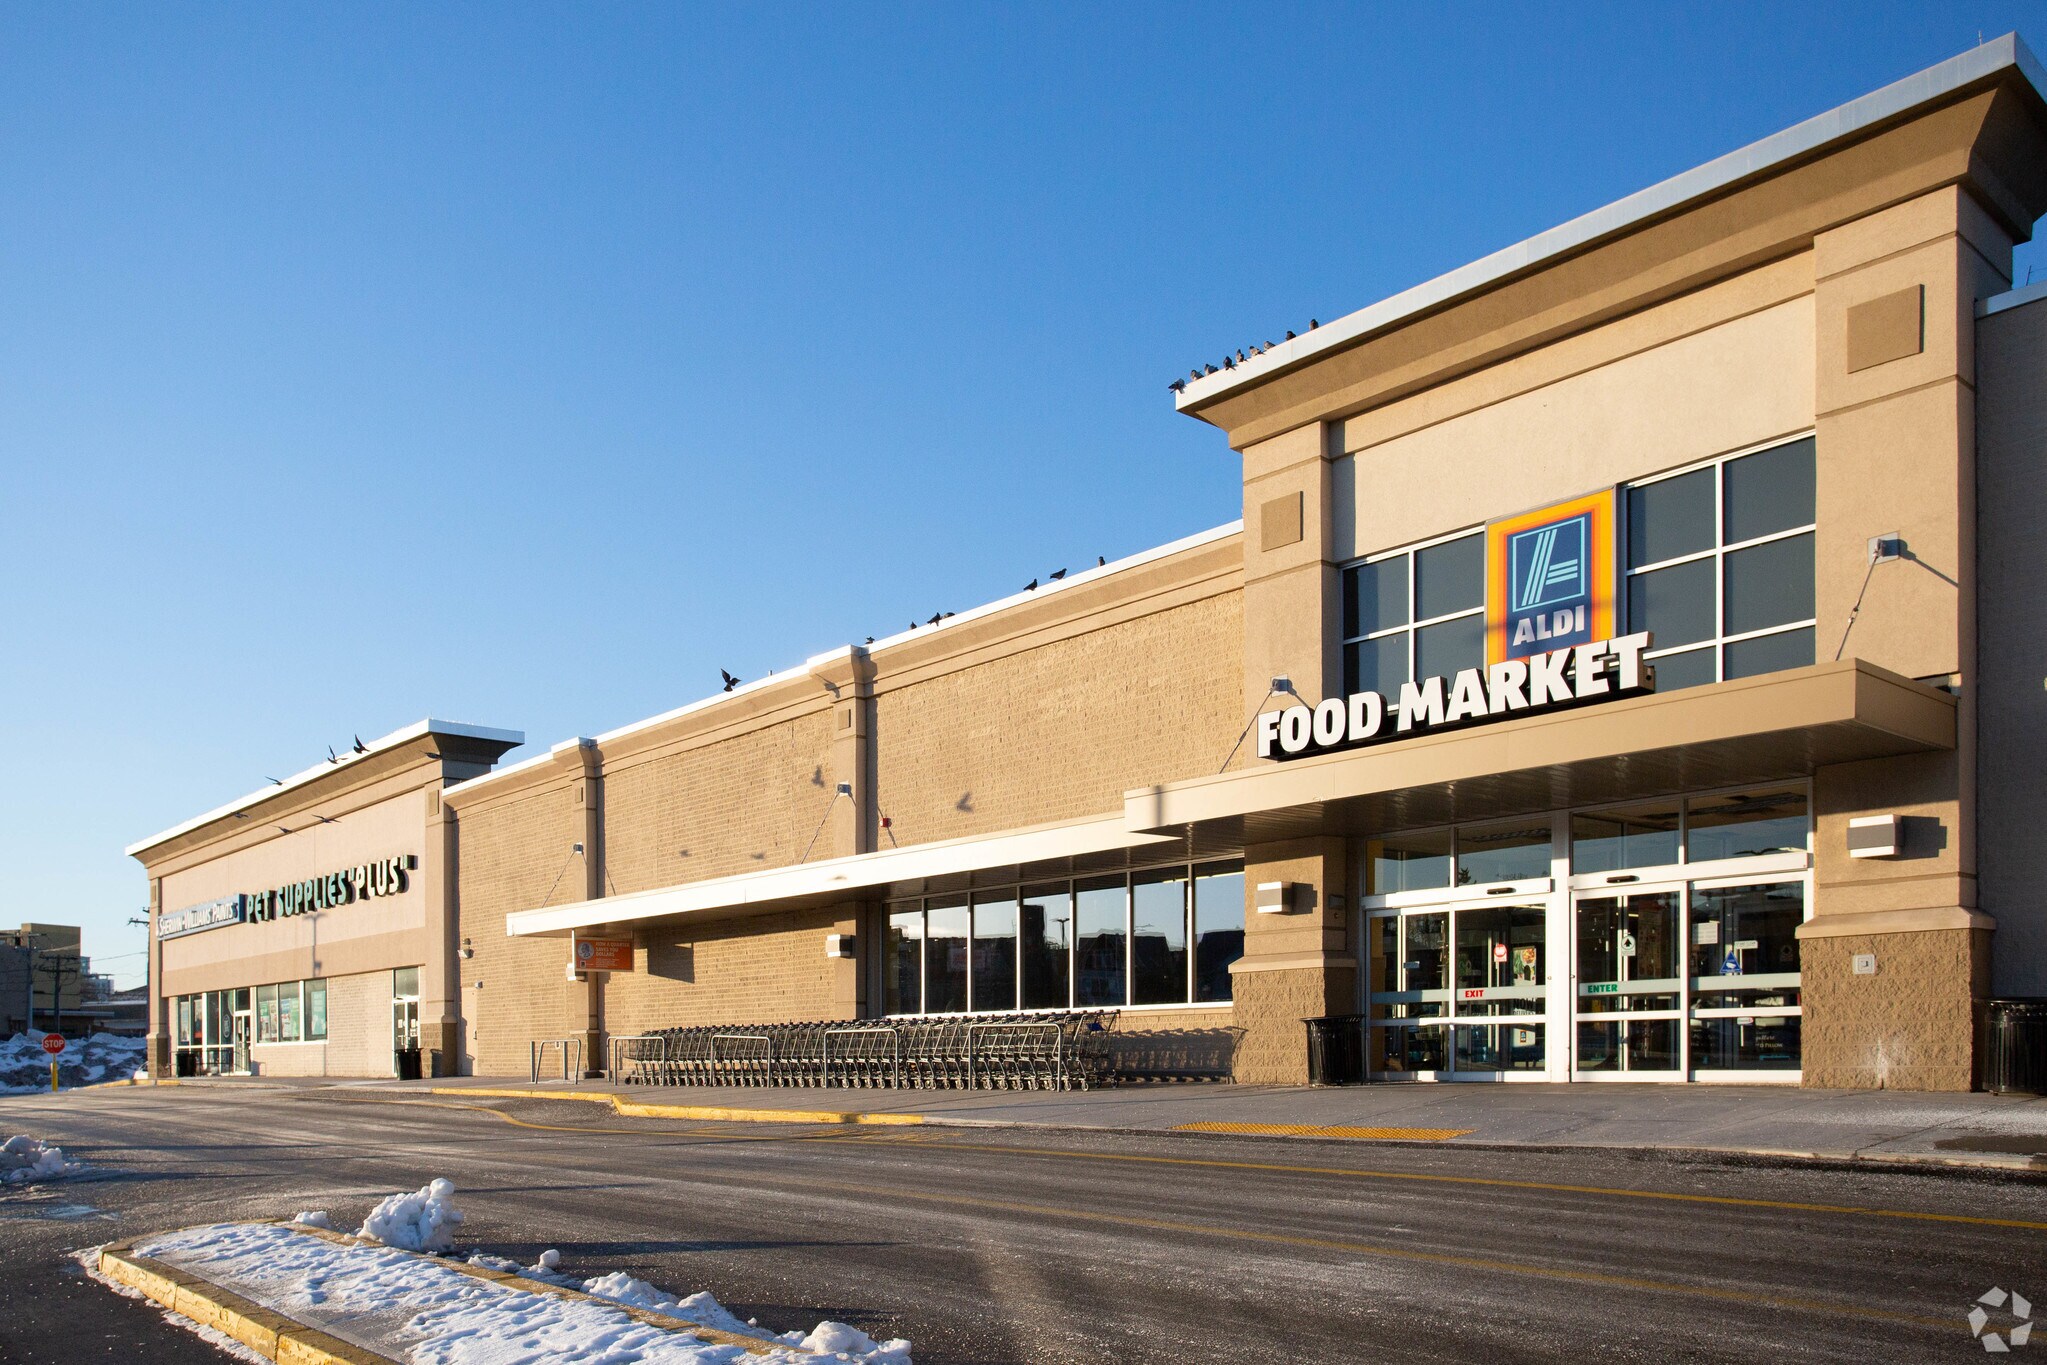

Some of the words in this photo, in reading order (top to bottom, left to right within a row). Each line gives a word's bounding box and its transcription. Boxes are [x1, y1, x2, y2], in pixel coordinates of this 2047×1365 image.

[1512, 605, 1585, 647] ALDI
[1257, 690, 1384, 759] FOOD
[1396, 630, 1653, 733] MARKET
[246, 890, 273, 923] PET
[276, 869, 348, 918] SUPPLIES
[1465, 989, 1484, 998] EXIT
[1587, 984, 1618, 993] ENTER
[44, 1039, 64, 1048] STOP
